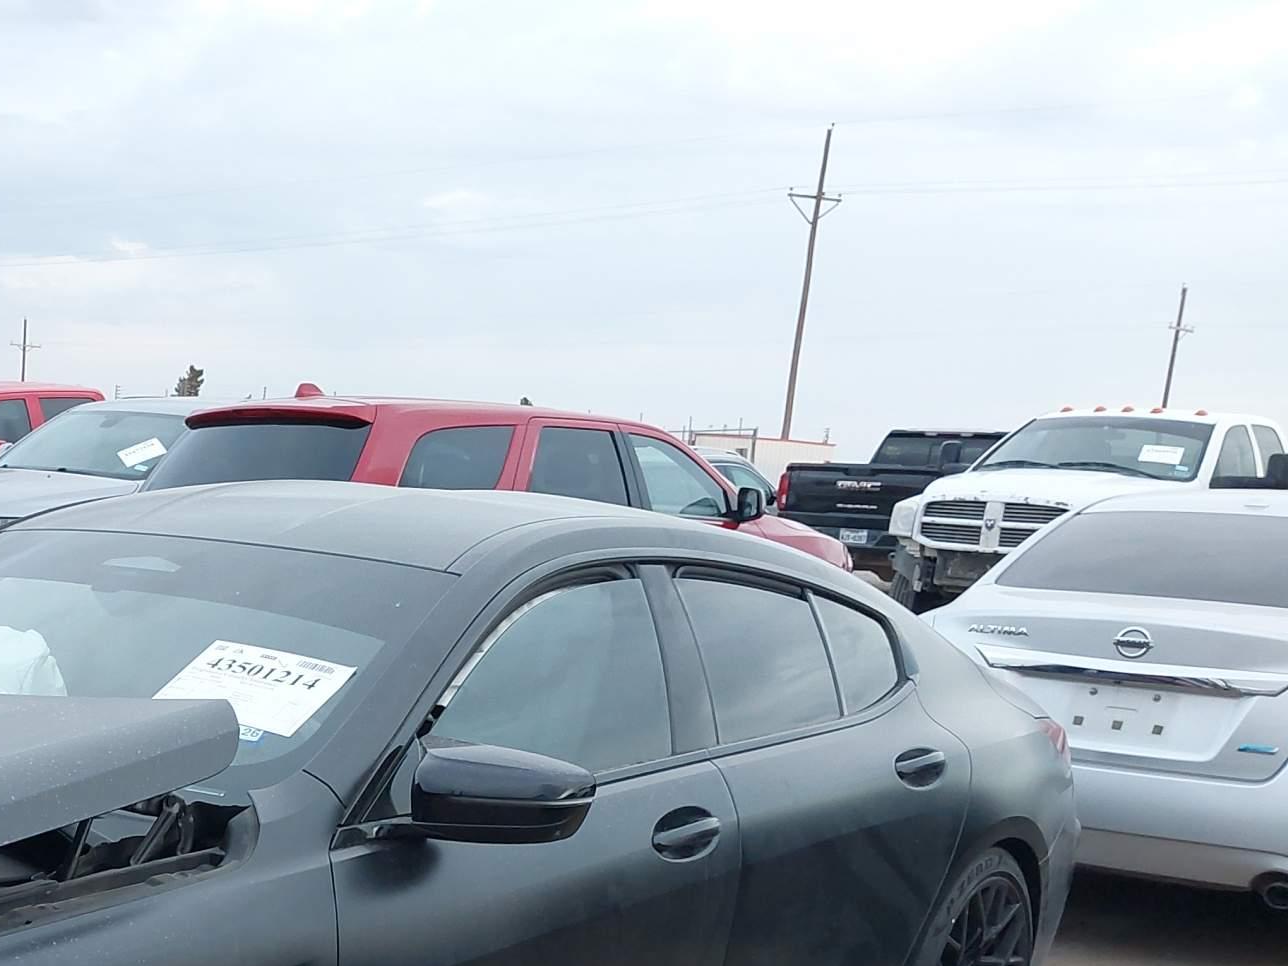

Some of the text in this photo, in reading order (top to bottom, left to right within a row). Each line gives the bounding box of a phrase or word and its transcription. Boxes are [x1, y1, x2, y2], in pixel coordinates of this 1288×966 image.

[968, 623, 1029, 637] ALTIMA
[206, 656, 321, 690] 43501214
[241, 728, 260, 738] 26
